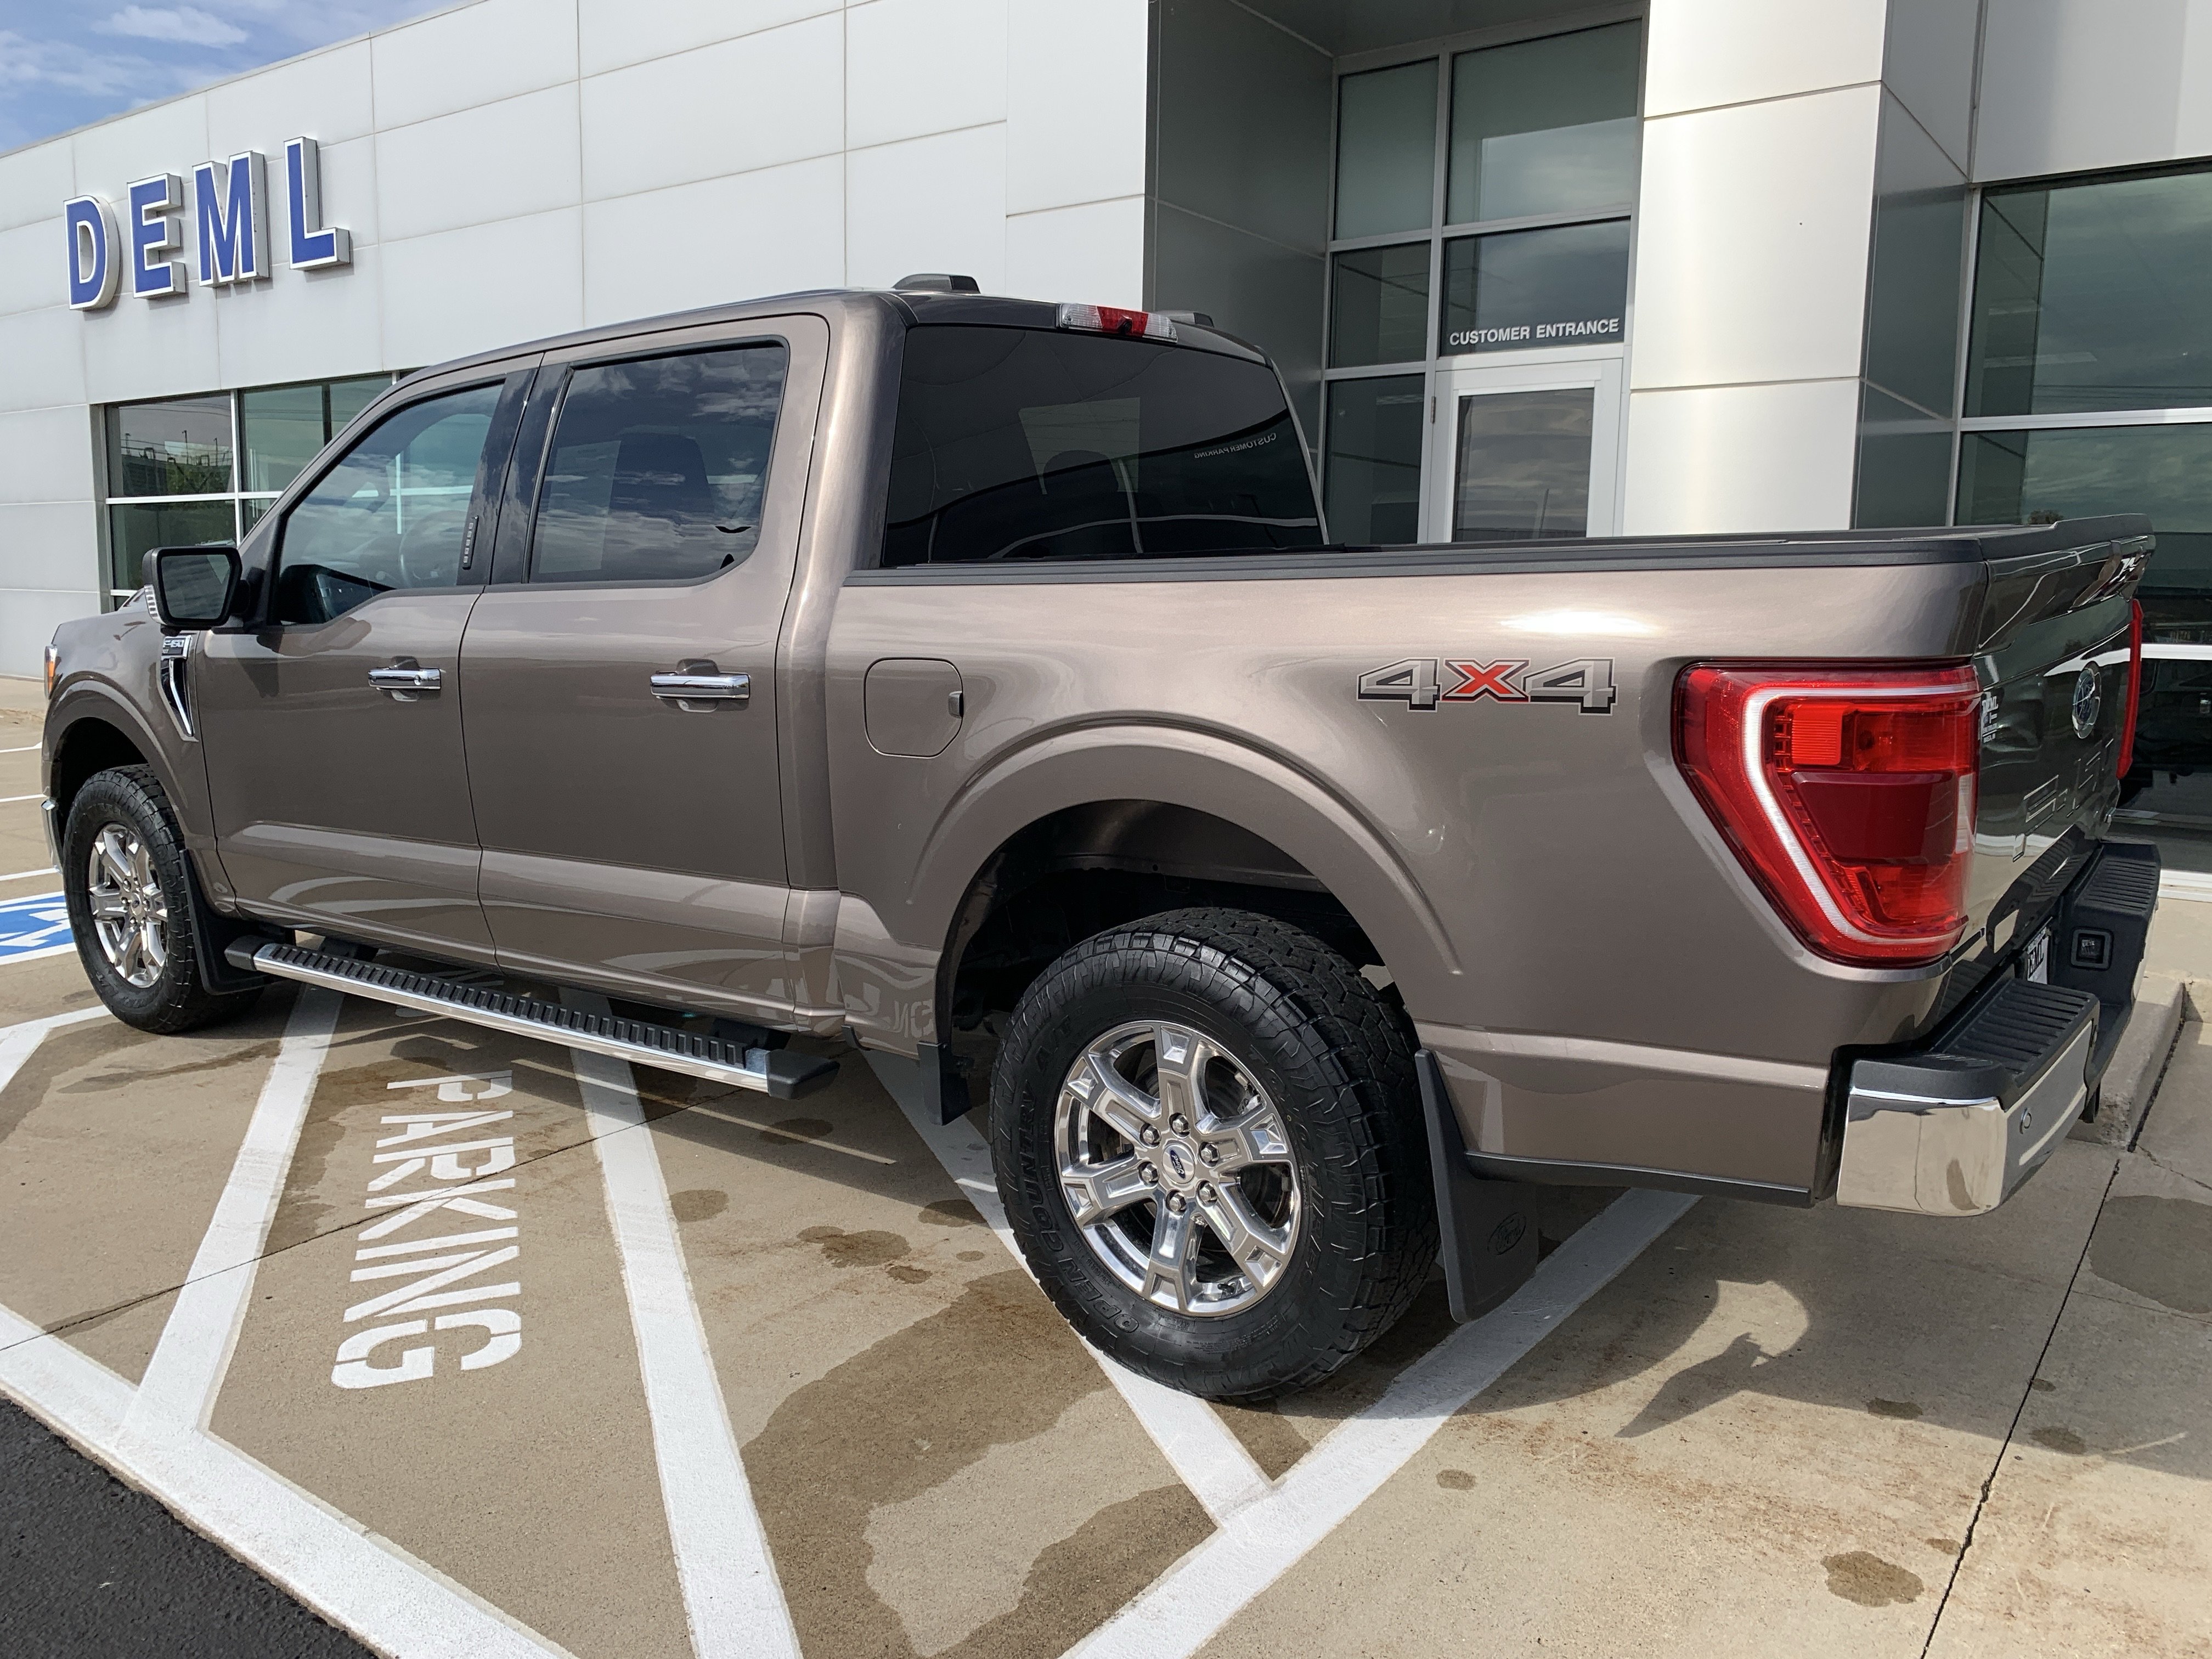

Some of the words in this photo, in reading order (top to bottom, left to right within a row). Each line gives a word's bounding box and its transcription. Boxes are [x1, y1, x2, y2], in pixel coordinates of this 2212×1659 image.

[63, 136, 350, 311] DEML
[1449, 325, 1530, 346] CUSTOMER
[1536, 318, 1620, 339] ENTRANCE
[1171, 1152, 1185, 1176] Ford
[331, 1070, 522, 1390] PARKING
[1057, 1257, 1140, 1334] OPEN
